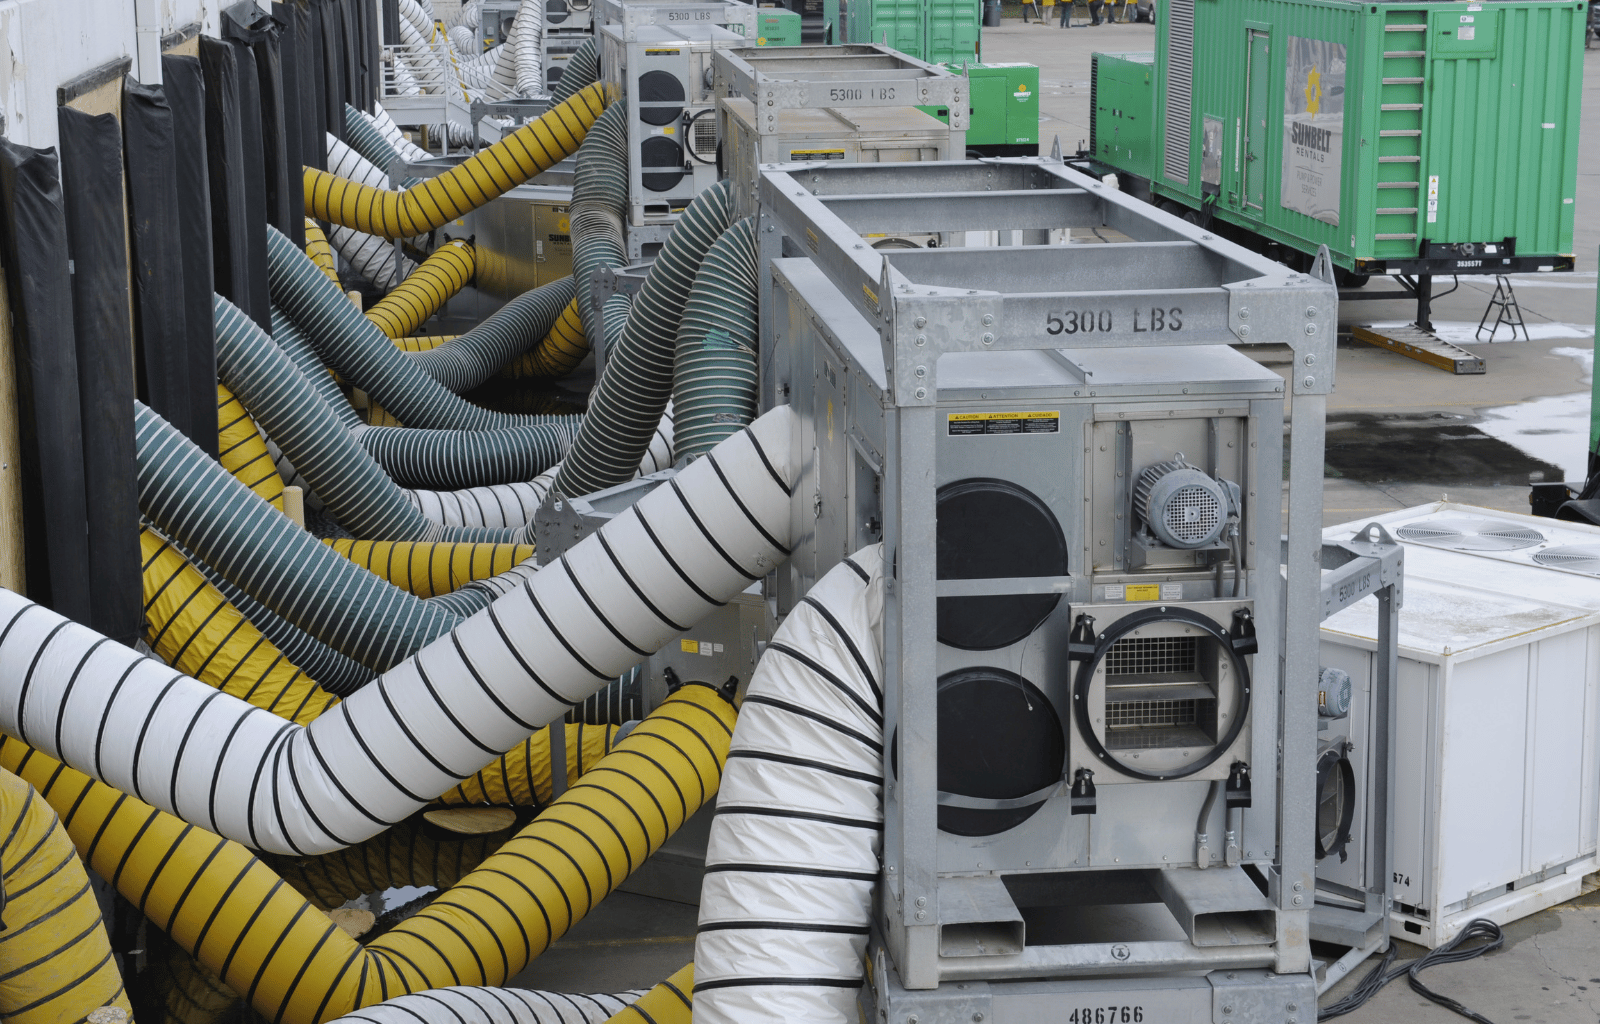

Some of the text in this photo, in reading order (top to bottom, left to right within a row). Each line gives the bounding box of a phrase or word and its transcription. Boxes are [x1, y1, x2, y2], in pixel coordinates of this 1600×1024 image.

[668, 12, 711, 21] 5300 LBS
[829, 88, 863, 102] 5300
[1291, 121, 1332, 153] SUNBELT
[1296, 147, 1325, 163] RENTALS
[1046, 307, 1183, 335] 5300 LBS
[1339, 573, 1370, 602] 5300 LBS
[1068, 1006, 1143, 1024] 486766
